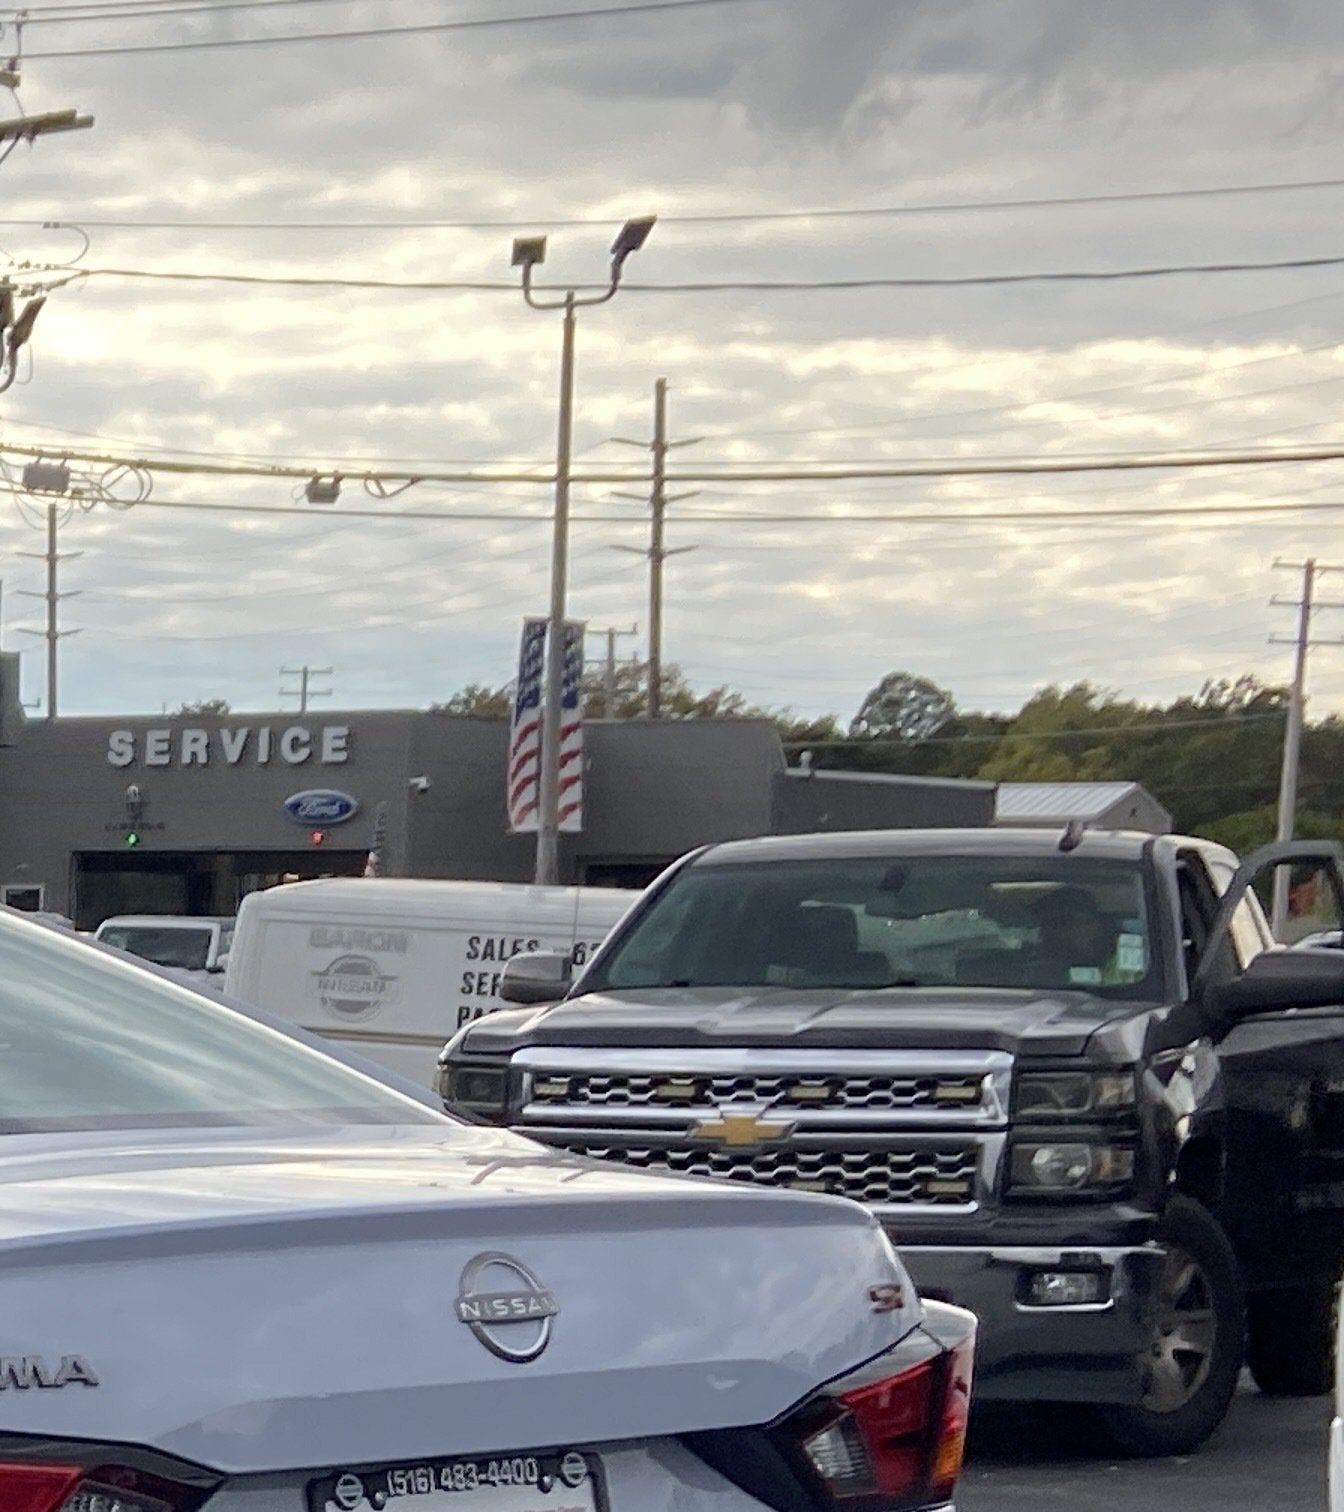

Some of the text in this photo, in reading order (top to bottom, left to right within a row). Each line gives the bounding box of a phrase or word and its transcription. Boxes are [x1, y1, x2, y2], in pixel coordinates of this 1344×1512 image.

[108, 726, 351, 767] SERVICE
[459, 1296, 555, 1318] NISSAN
[386, 1457, 539, 1497] (516) 483-4400
